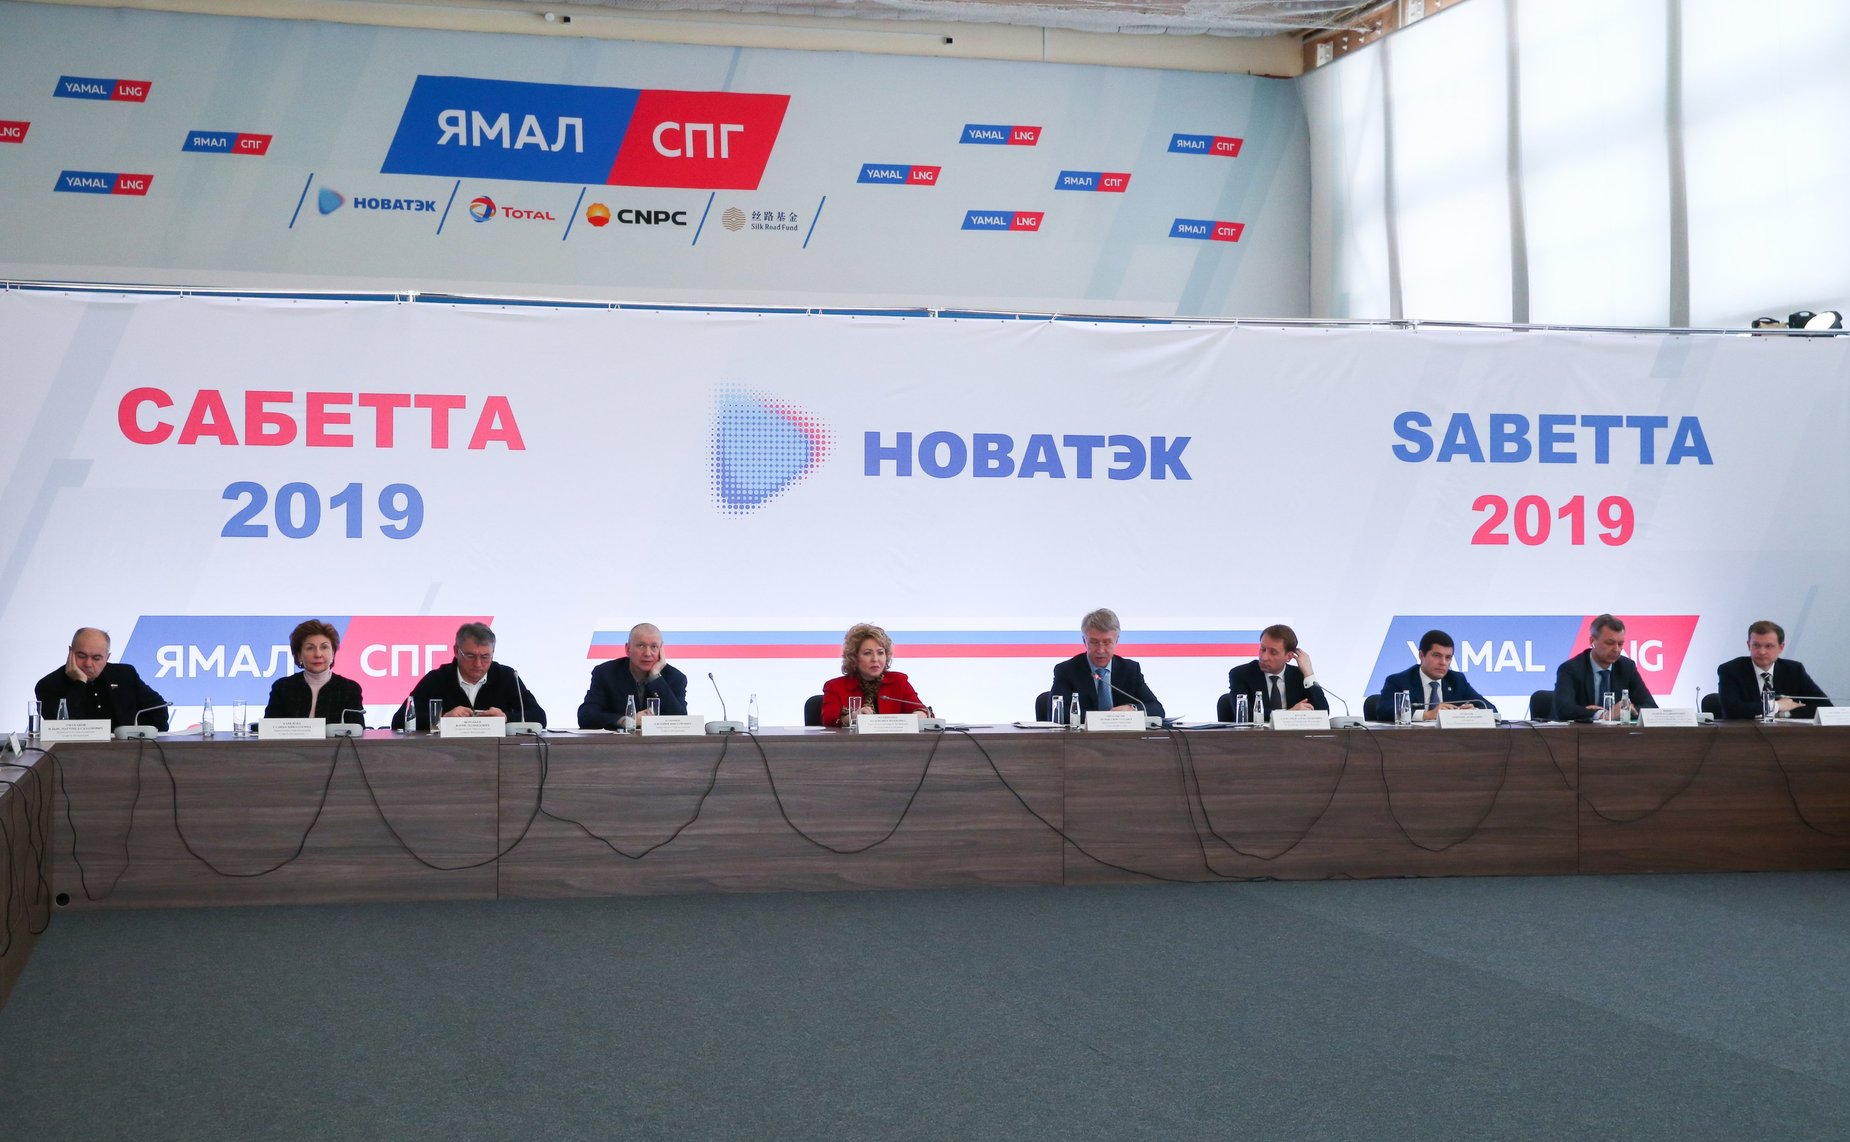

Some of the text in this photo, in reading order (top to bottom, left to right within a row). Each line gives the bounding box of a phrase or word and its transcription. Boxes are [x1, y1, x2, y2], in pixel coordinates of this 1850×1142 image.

[65, 82, 142, 97] YAMAL LNG
[436, 109, 744, 159] ЯМАЛ СПГ
[969, 129, 1034, 141] YAMAL LNG
[193, 136, 262, 150] ЯМАЛ СПГ
[1176, 140, 1235, 151] ЯМАЛ СПГ
[866, 169, 933, 181] YAMAL LNG
[1064, 177, 1123, 187] ЯМАЛ СПГ
[66, 176, 144, 191] YAMAL LNG
[353, 197, 436, 213] НОВАТЭК
[502, 206, 556, 221] TOTAL
[617, 208, 688, 227] CNPC
[971, 215, 1036, 227] YAMAL LNG
[1178, 225, 1236, 236] ЯМАЛ СПГ
[117, 387, 527, 451] САБЕТТА
[1391, 411, 1714, 466] SABETTA
[864, 430, 1193, 481] НОВАТЭК
[220, 481, 425, 540] 2019
[1471, 494, 1636, 547] 2019
[360, 643, 449, 678] СПГ
